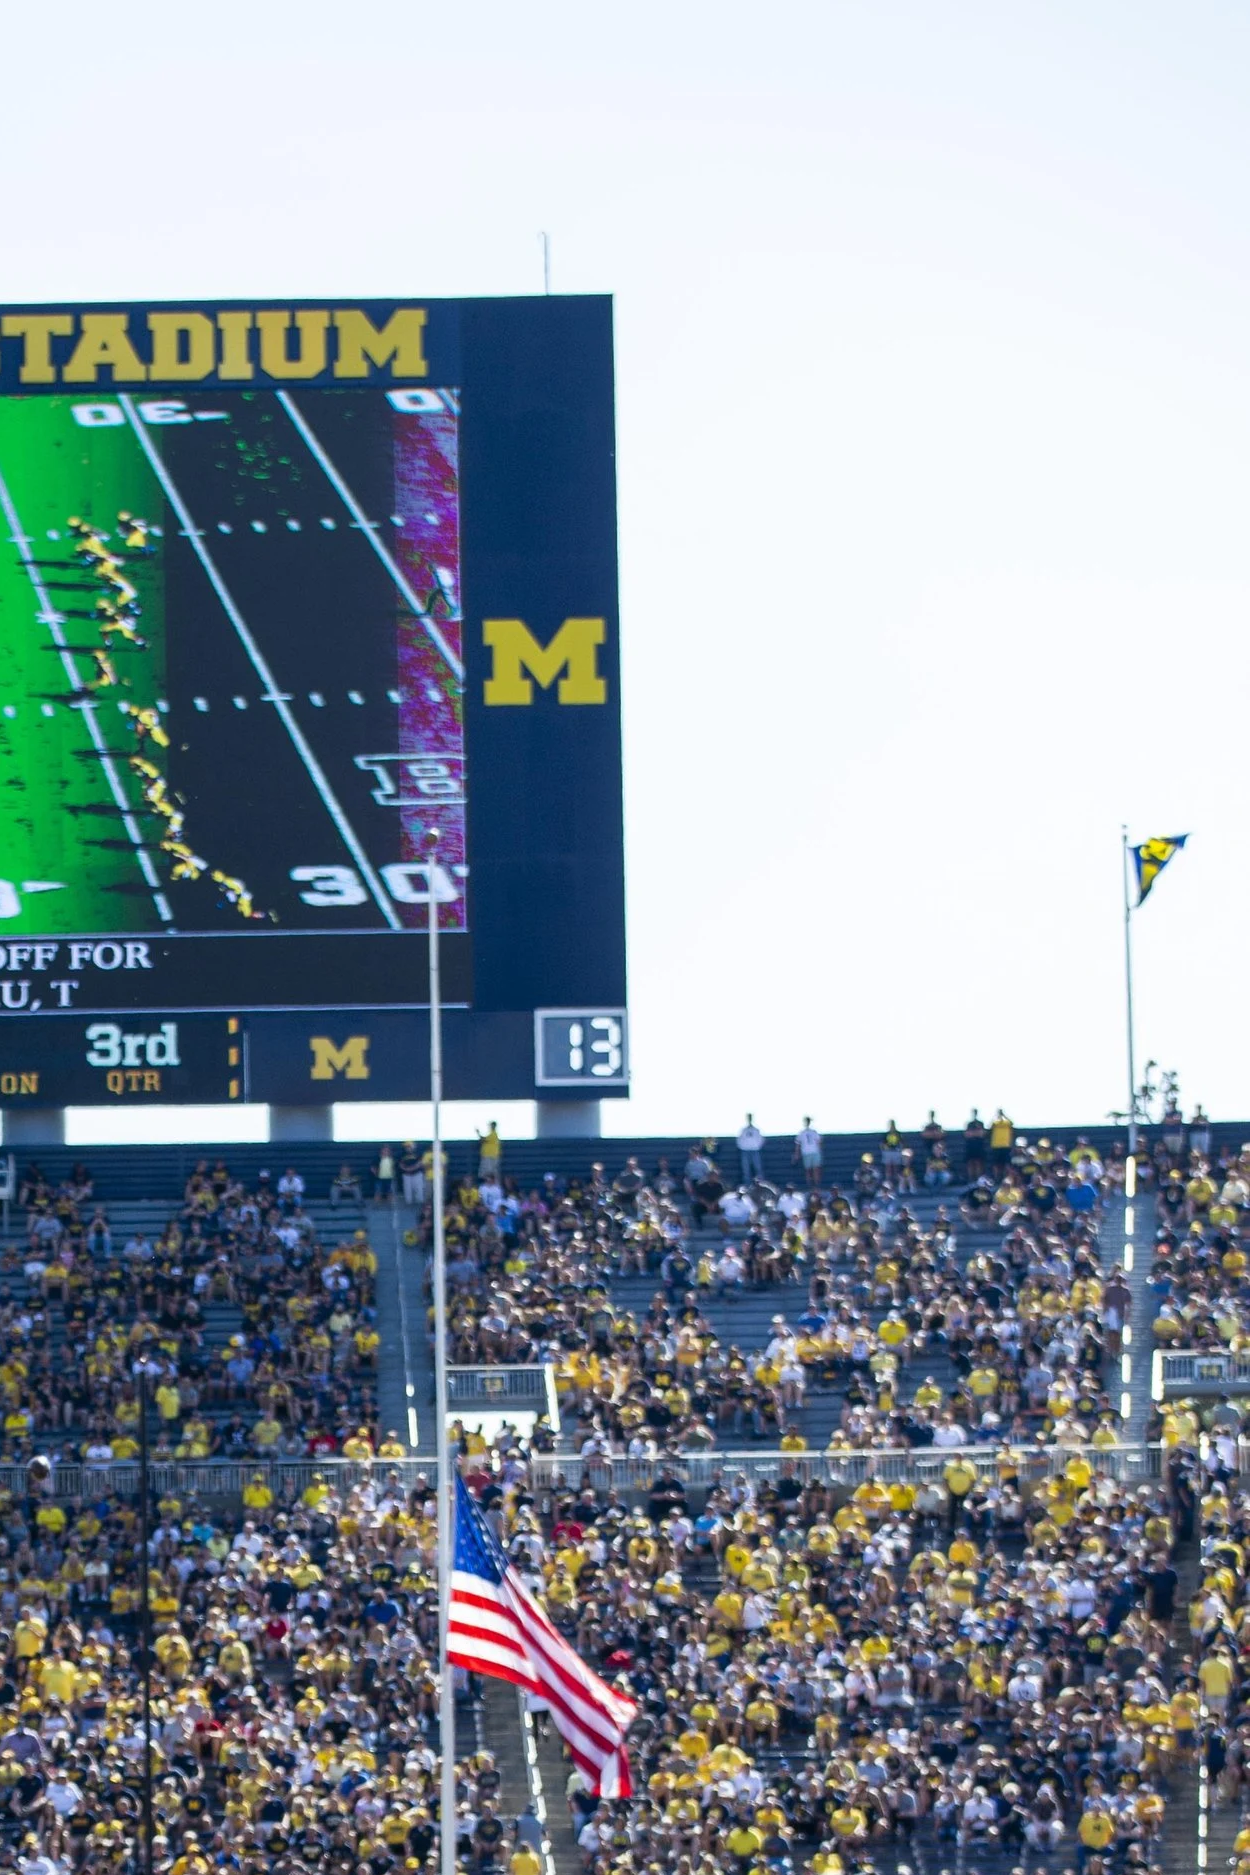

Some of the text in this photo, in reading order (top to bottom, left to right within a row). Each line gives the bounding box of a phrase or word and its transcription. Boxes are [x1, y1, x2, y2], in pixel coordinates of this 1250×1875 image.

[482, 617, 607, 706] M
[68, 940, 153, 970] FOR
[51, 978, 80, 1009] T
[85, 1022, 180, 1069] 3rd
[310, 1036, 370, 1080] M
[568, 1017, 622, 1077] 13
[0, 1071, 39, 1094] ON
[106, 1070, 161, 1093] QTR
